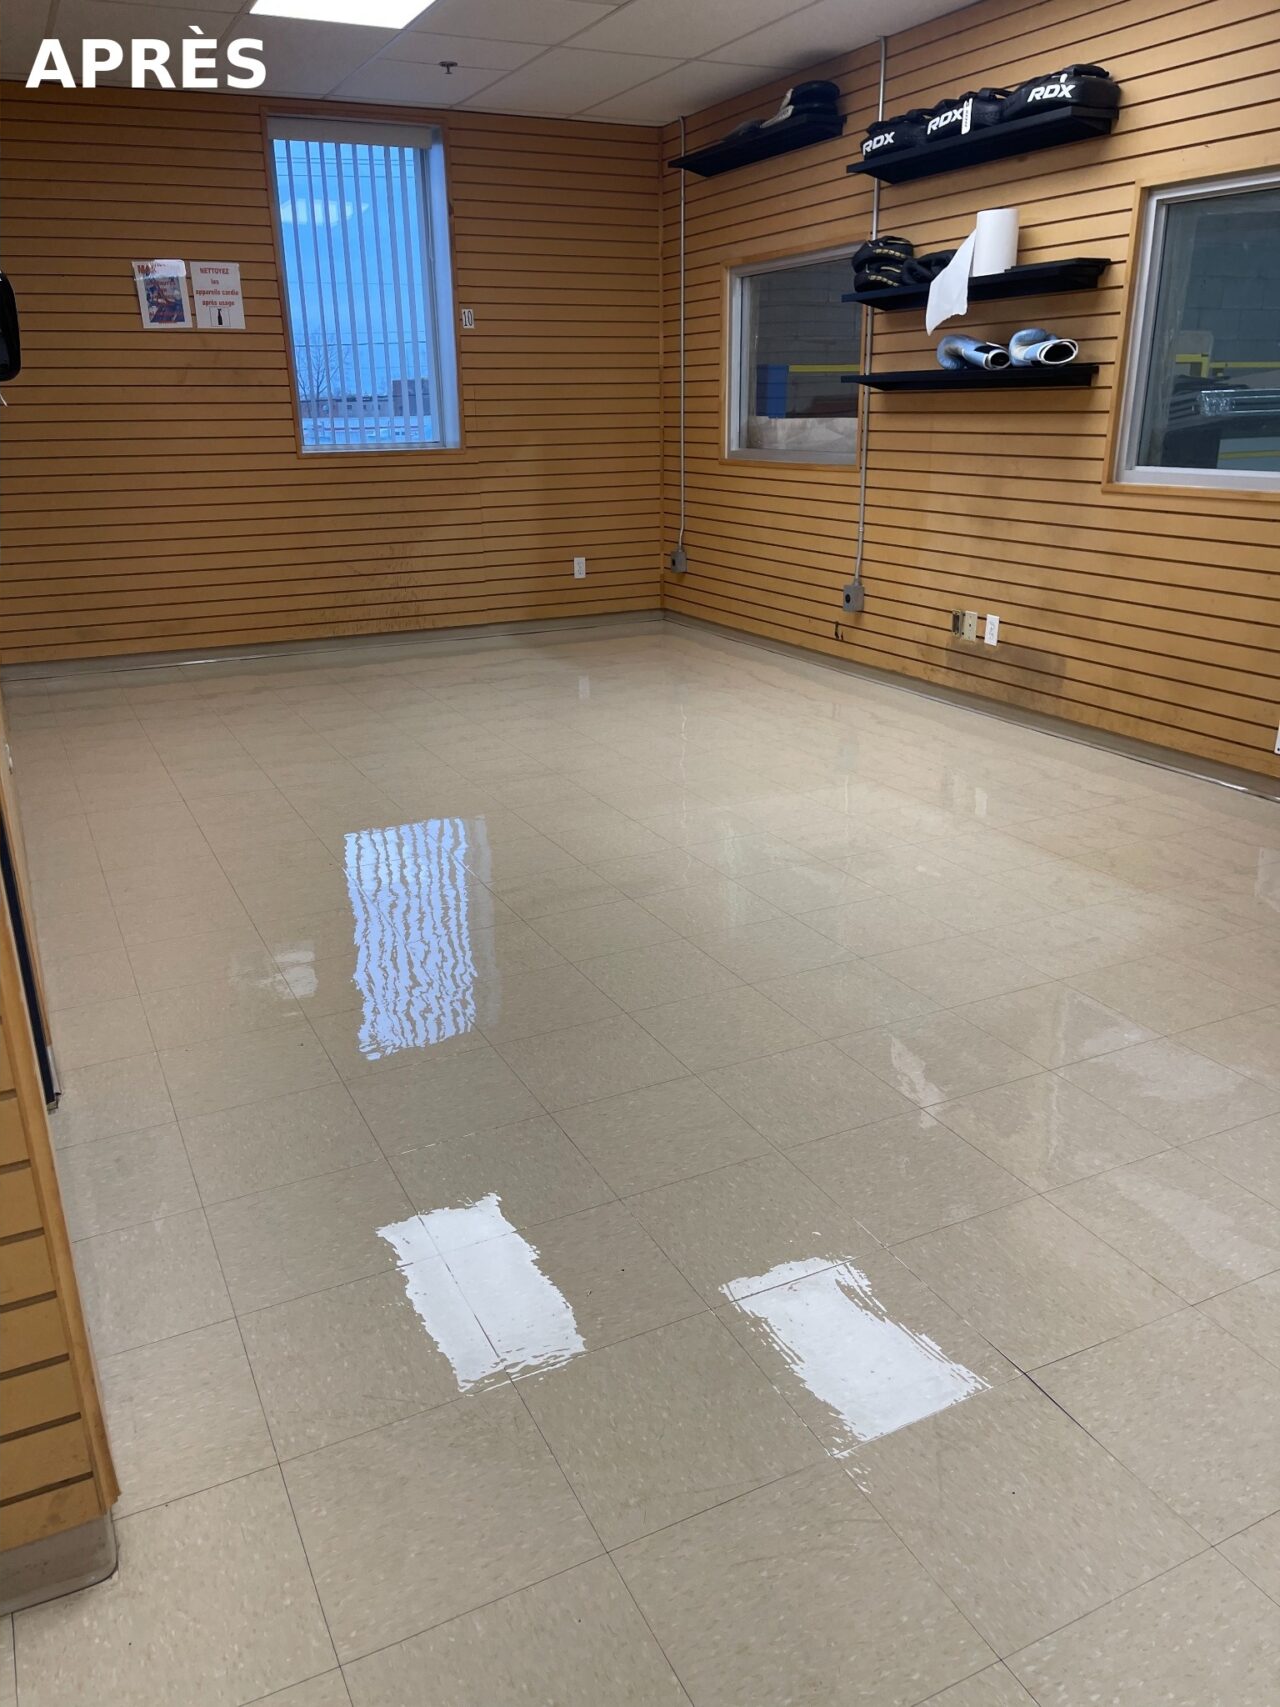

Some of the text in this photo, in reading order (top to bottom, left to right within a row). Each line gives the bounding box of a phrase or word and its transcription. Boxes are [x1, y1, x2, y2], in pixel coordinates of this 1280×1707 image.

[1026, 83, 1077, 103] RDX
[926, 107, 965, 135] RDX
[862, 131, 896, 156] RDX
[199, 267, 229, 275] NETTOYEZ
[195, 288, 221, 297] appareils
[463, 310, 473, 327] 10
